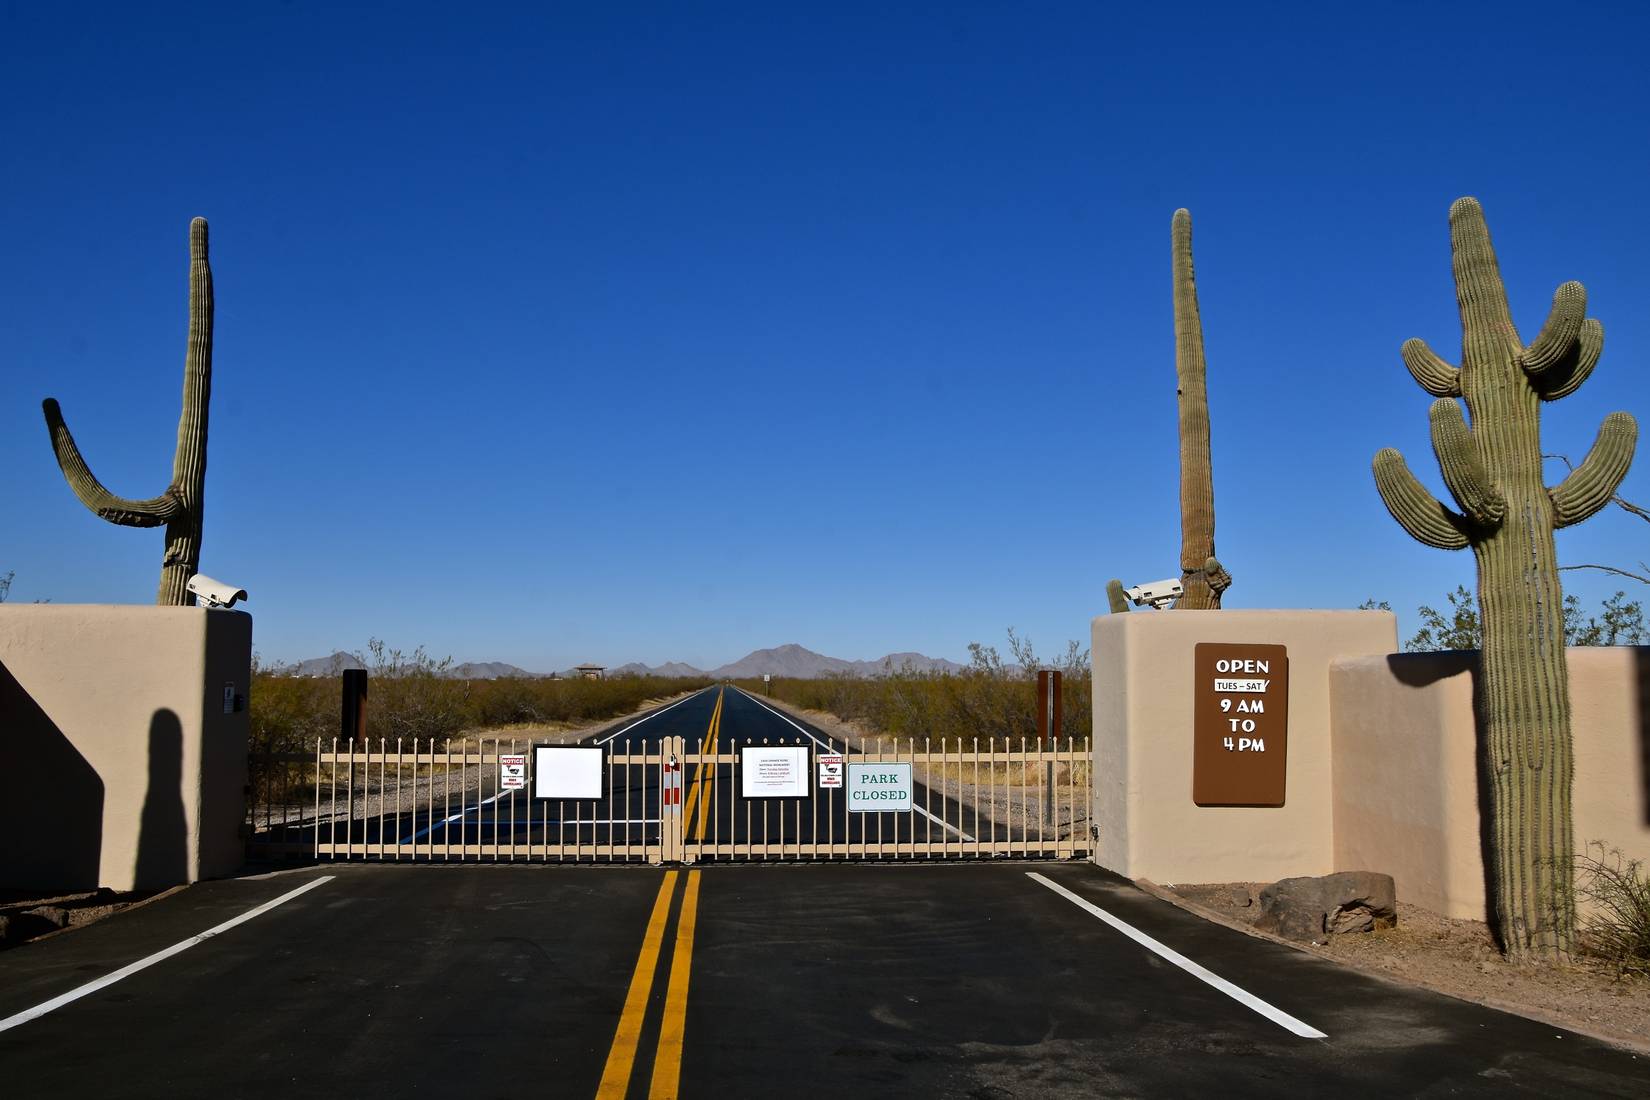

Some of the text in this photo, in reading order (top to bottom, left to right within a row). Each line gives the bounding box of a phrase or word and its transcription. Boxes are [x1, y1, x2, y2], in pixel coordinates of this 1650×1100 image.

[1216, 659, 1269, 673] OPEN
[1217, 682, 1238, 690] TUES
[1246, 682, 1262, 691] SAT
[1220, 699, 1264, 713] 9 AM
[1229, 718, 1256, 732] TO
[1223, 737, 1265, 752] 4 PM
[861, 774, 898, 784] PARK
[853, 790, 907, 800] CLOSED
